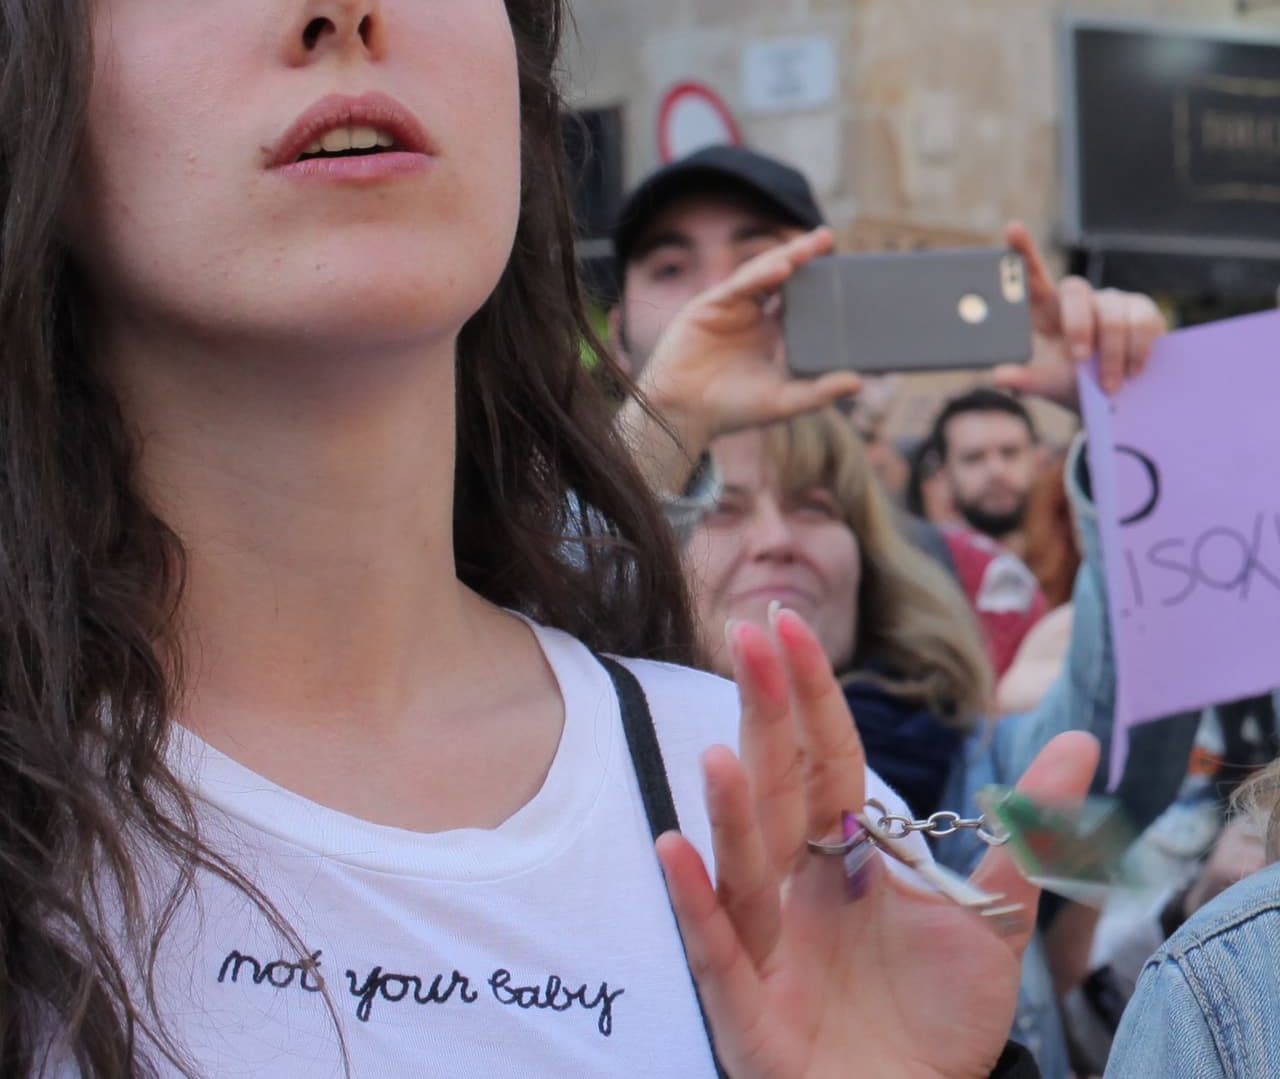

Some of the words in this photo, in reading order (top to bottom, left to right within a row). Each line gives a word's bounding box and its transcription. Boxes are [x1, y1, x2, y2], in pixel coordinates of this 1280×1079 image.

[217, 948, 324, 993] not
[344, 965, 479, 1022] your
[487, 967, 625, 1037] baby
